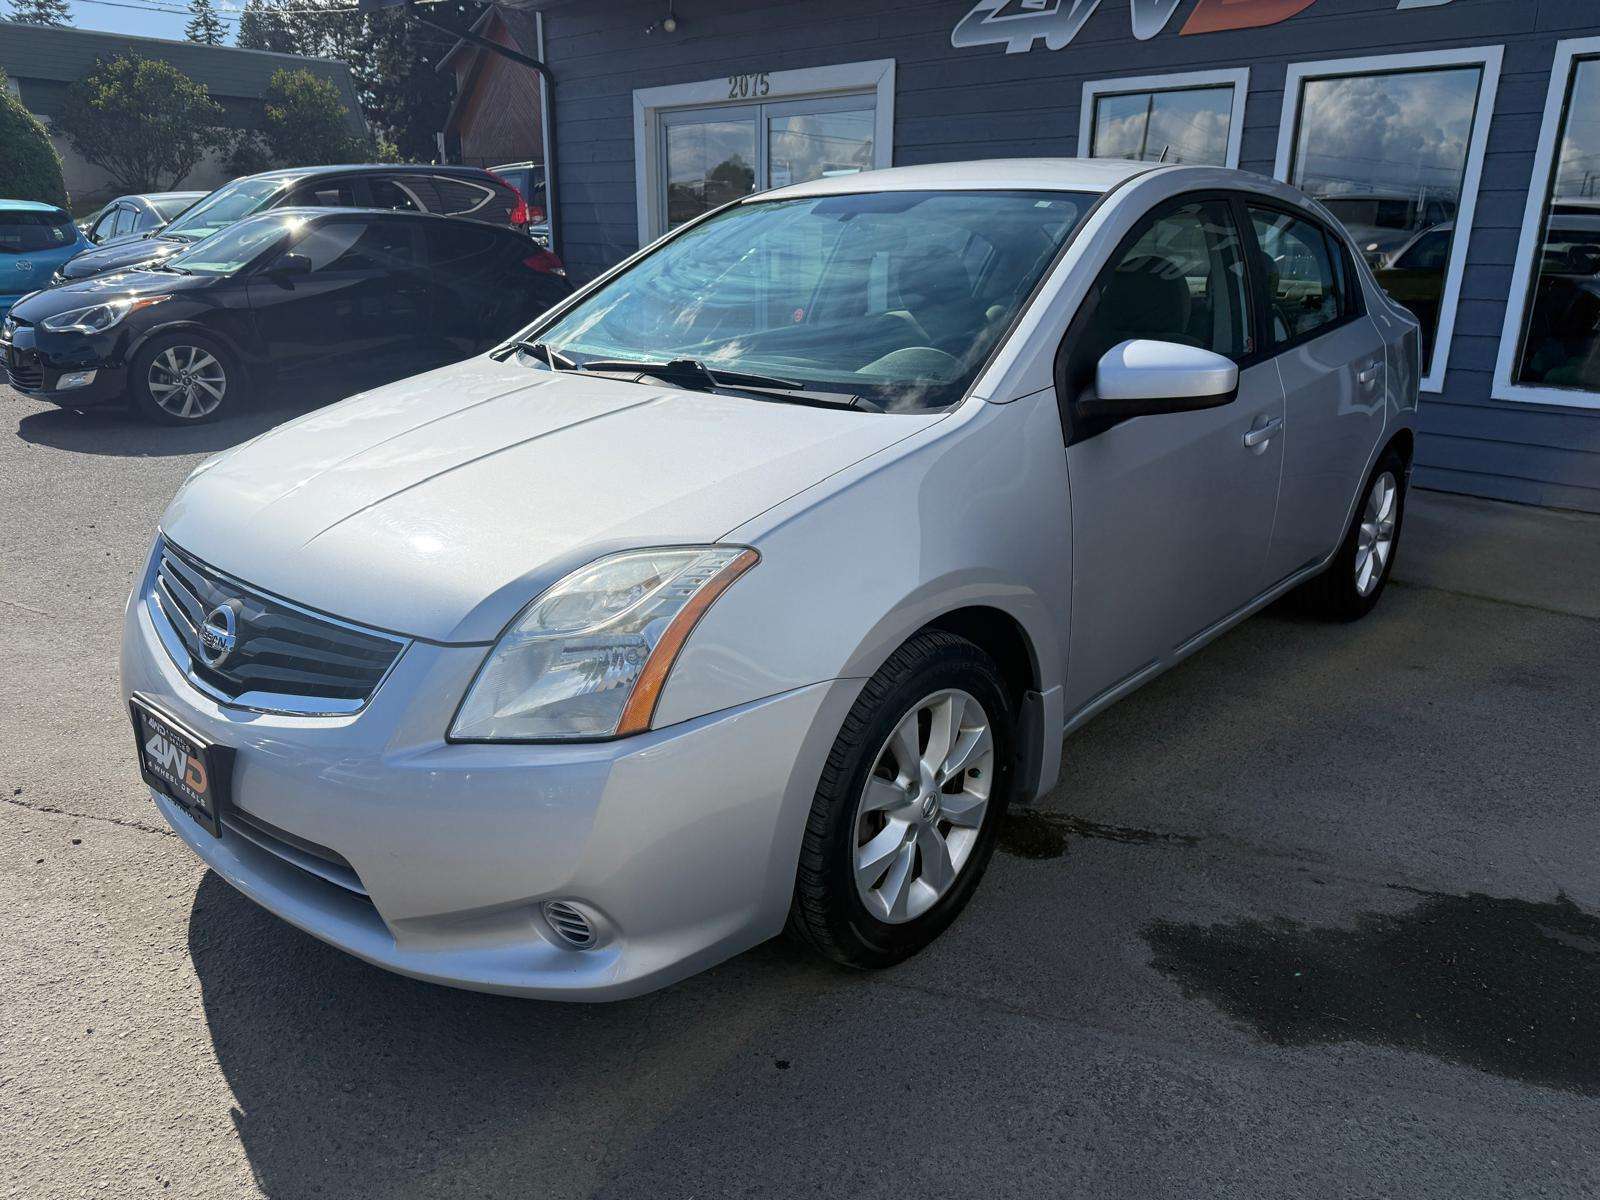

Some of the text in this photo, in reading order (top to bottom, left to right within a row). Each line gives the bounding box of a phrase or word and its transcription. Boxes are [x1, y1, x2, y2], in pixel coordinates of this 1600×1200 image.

[728, 72, 770, 99] 2075
[145, 733, 208, 794] 4WD
[154, 763, 179, 786] WHEEL
[181, 783, 206, 808] DEALS
